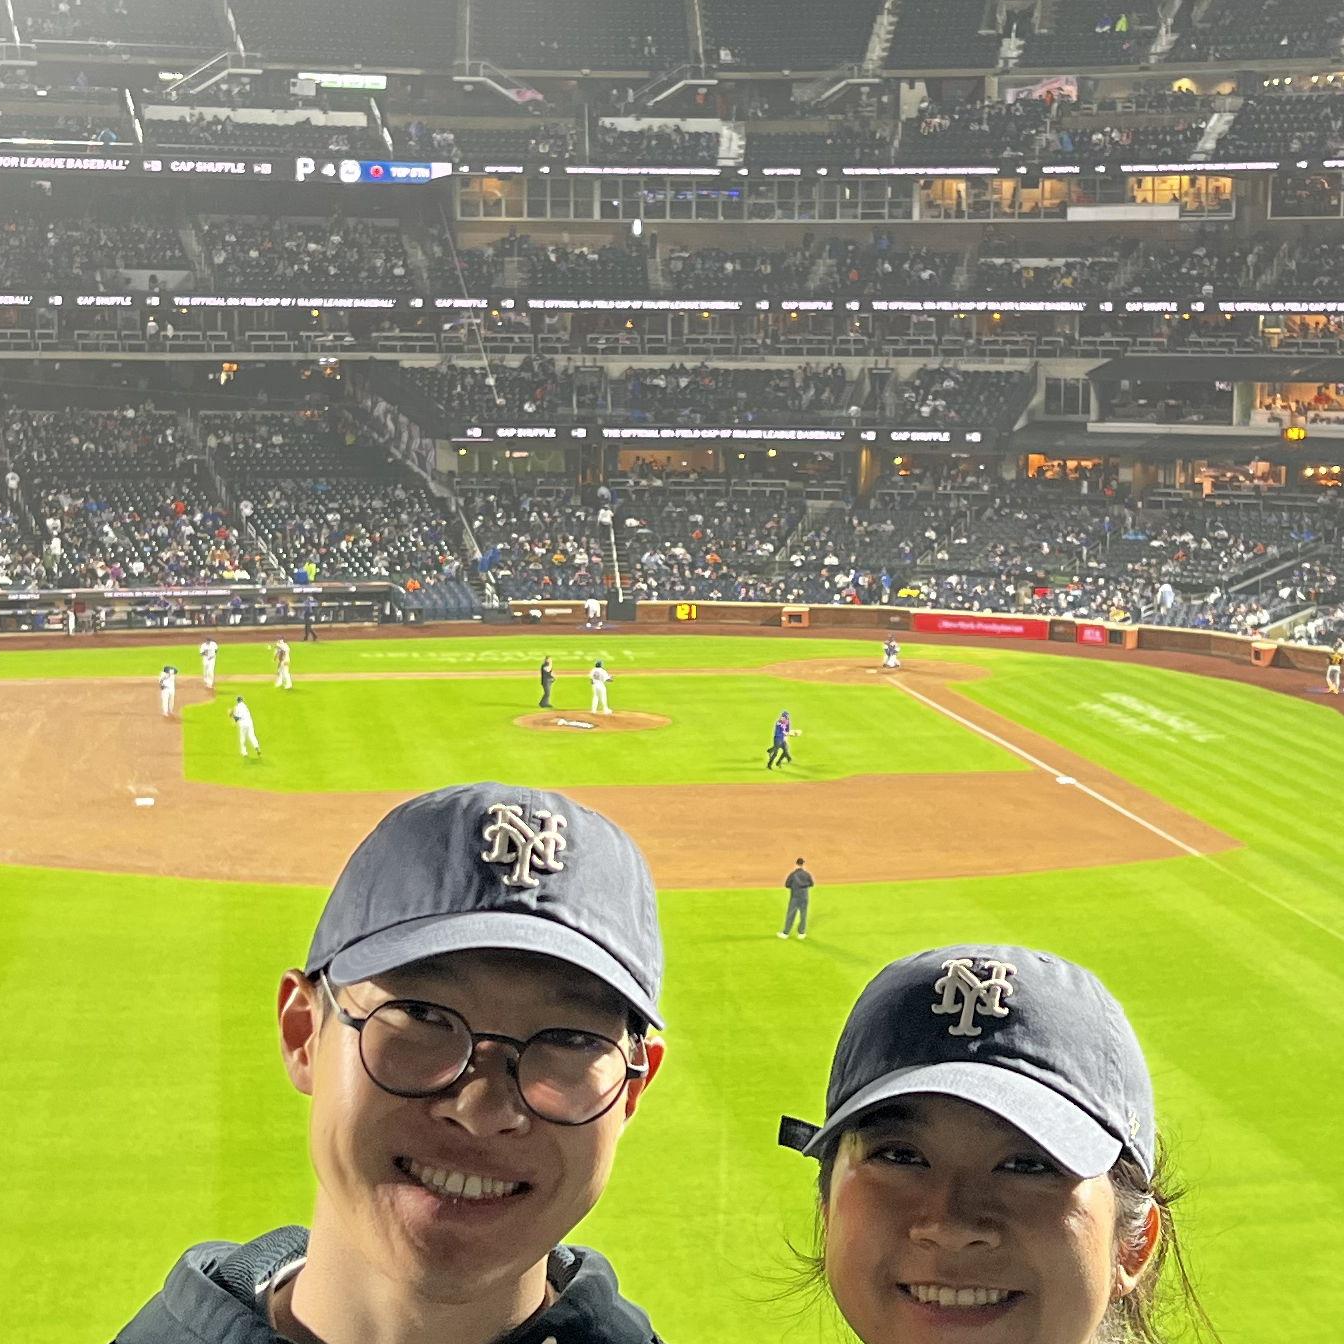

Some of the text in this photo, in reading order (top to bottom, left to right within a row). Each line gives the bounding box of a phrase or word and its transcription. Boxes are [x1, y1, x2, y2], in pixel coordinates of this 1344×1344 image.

[20, 157, 65, 169] LEAGUE
[171, 160, 196, 172] CAP
[481, 803, 567, 888] NY
[931, 958, 1017, 1036] NY
